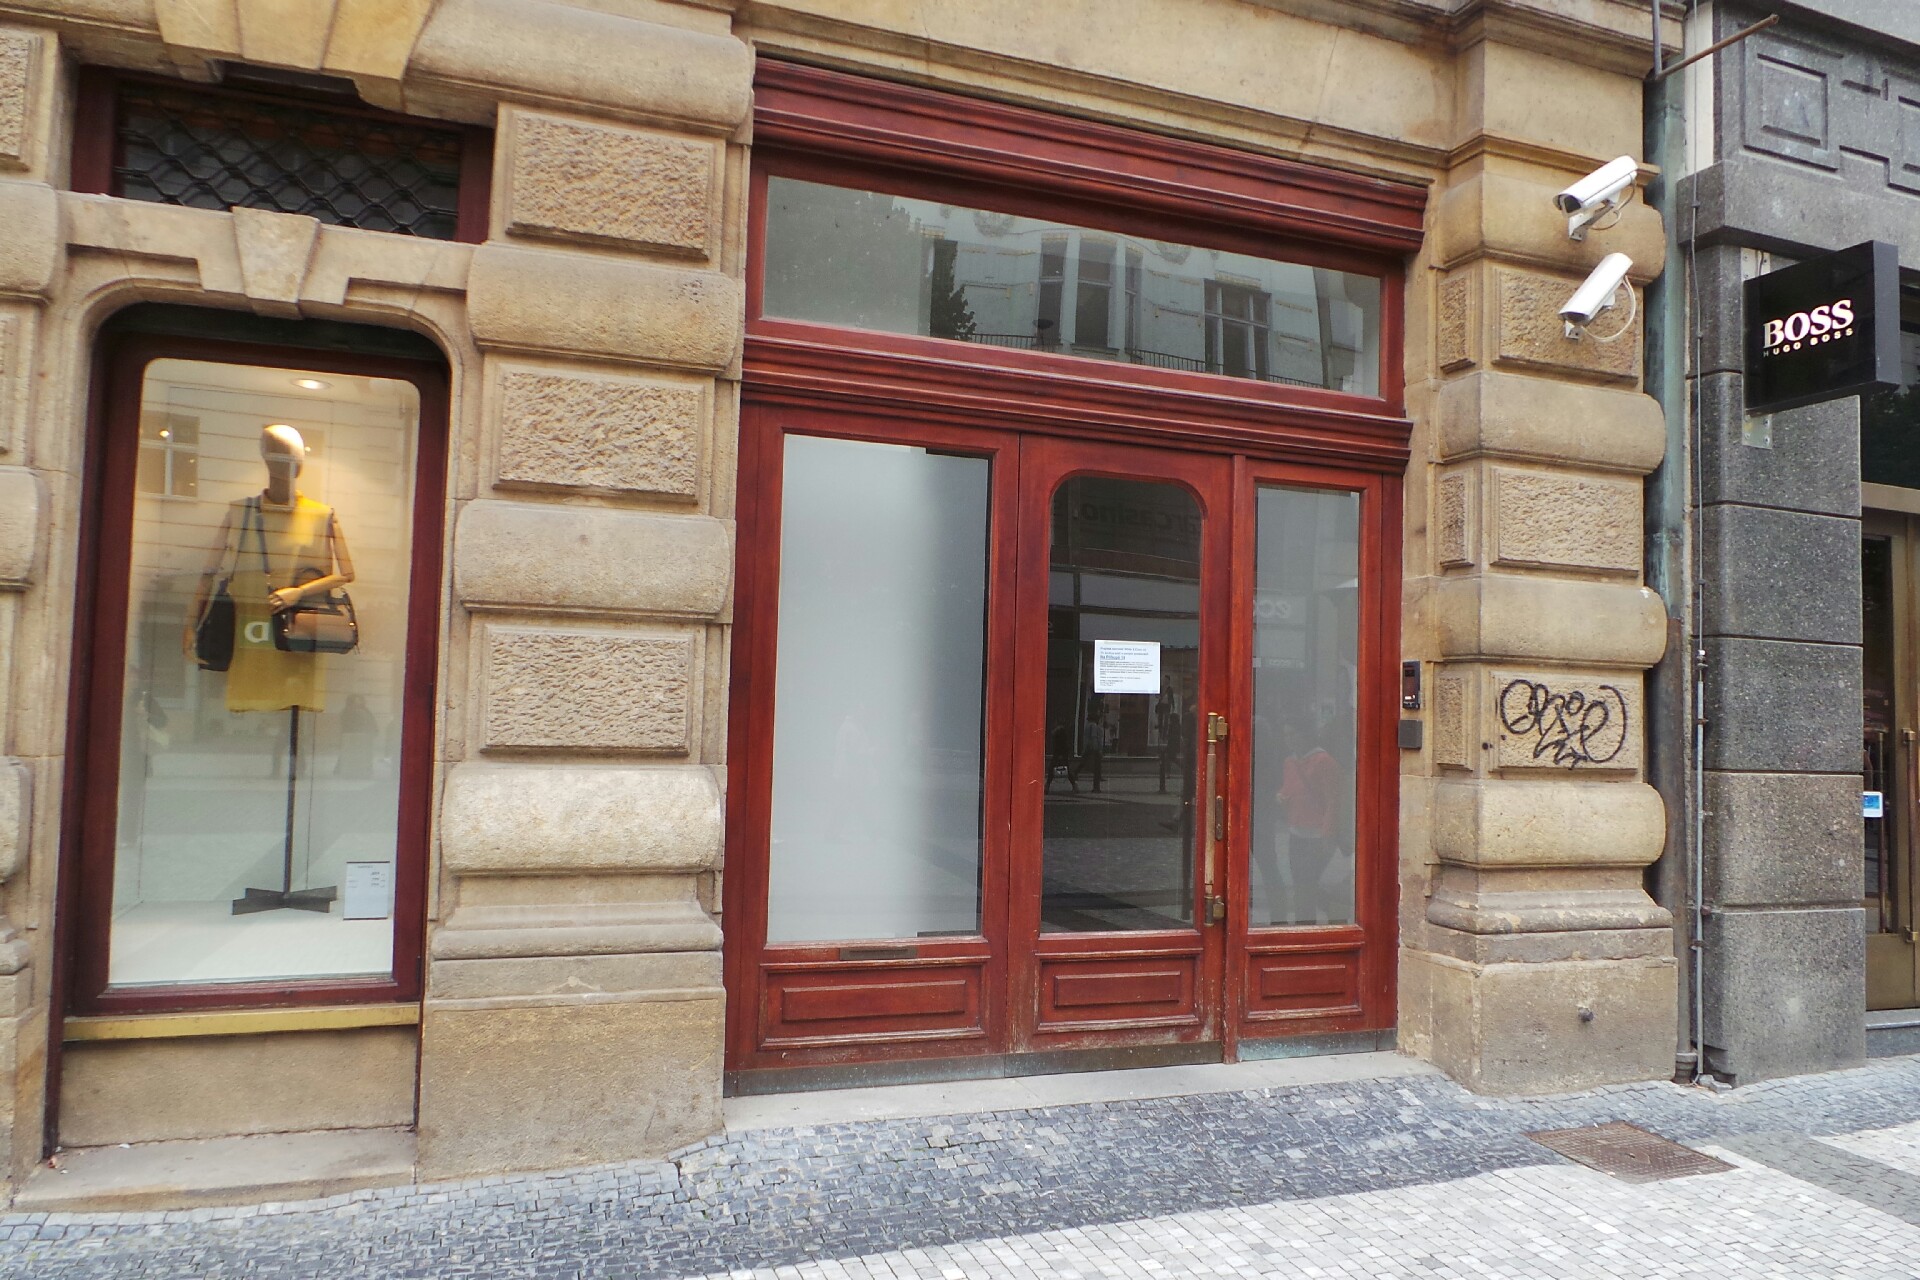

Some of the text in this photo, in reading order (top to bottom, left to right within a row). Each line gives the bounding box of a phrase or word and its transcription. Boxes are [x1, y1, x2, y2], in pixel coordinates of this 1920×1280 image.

[1763, 300, 1854, 349] BOSS
[1763, 327, 1854, 358] HUGO BOSS
